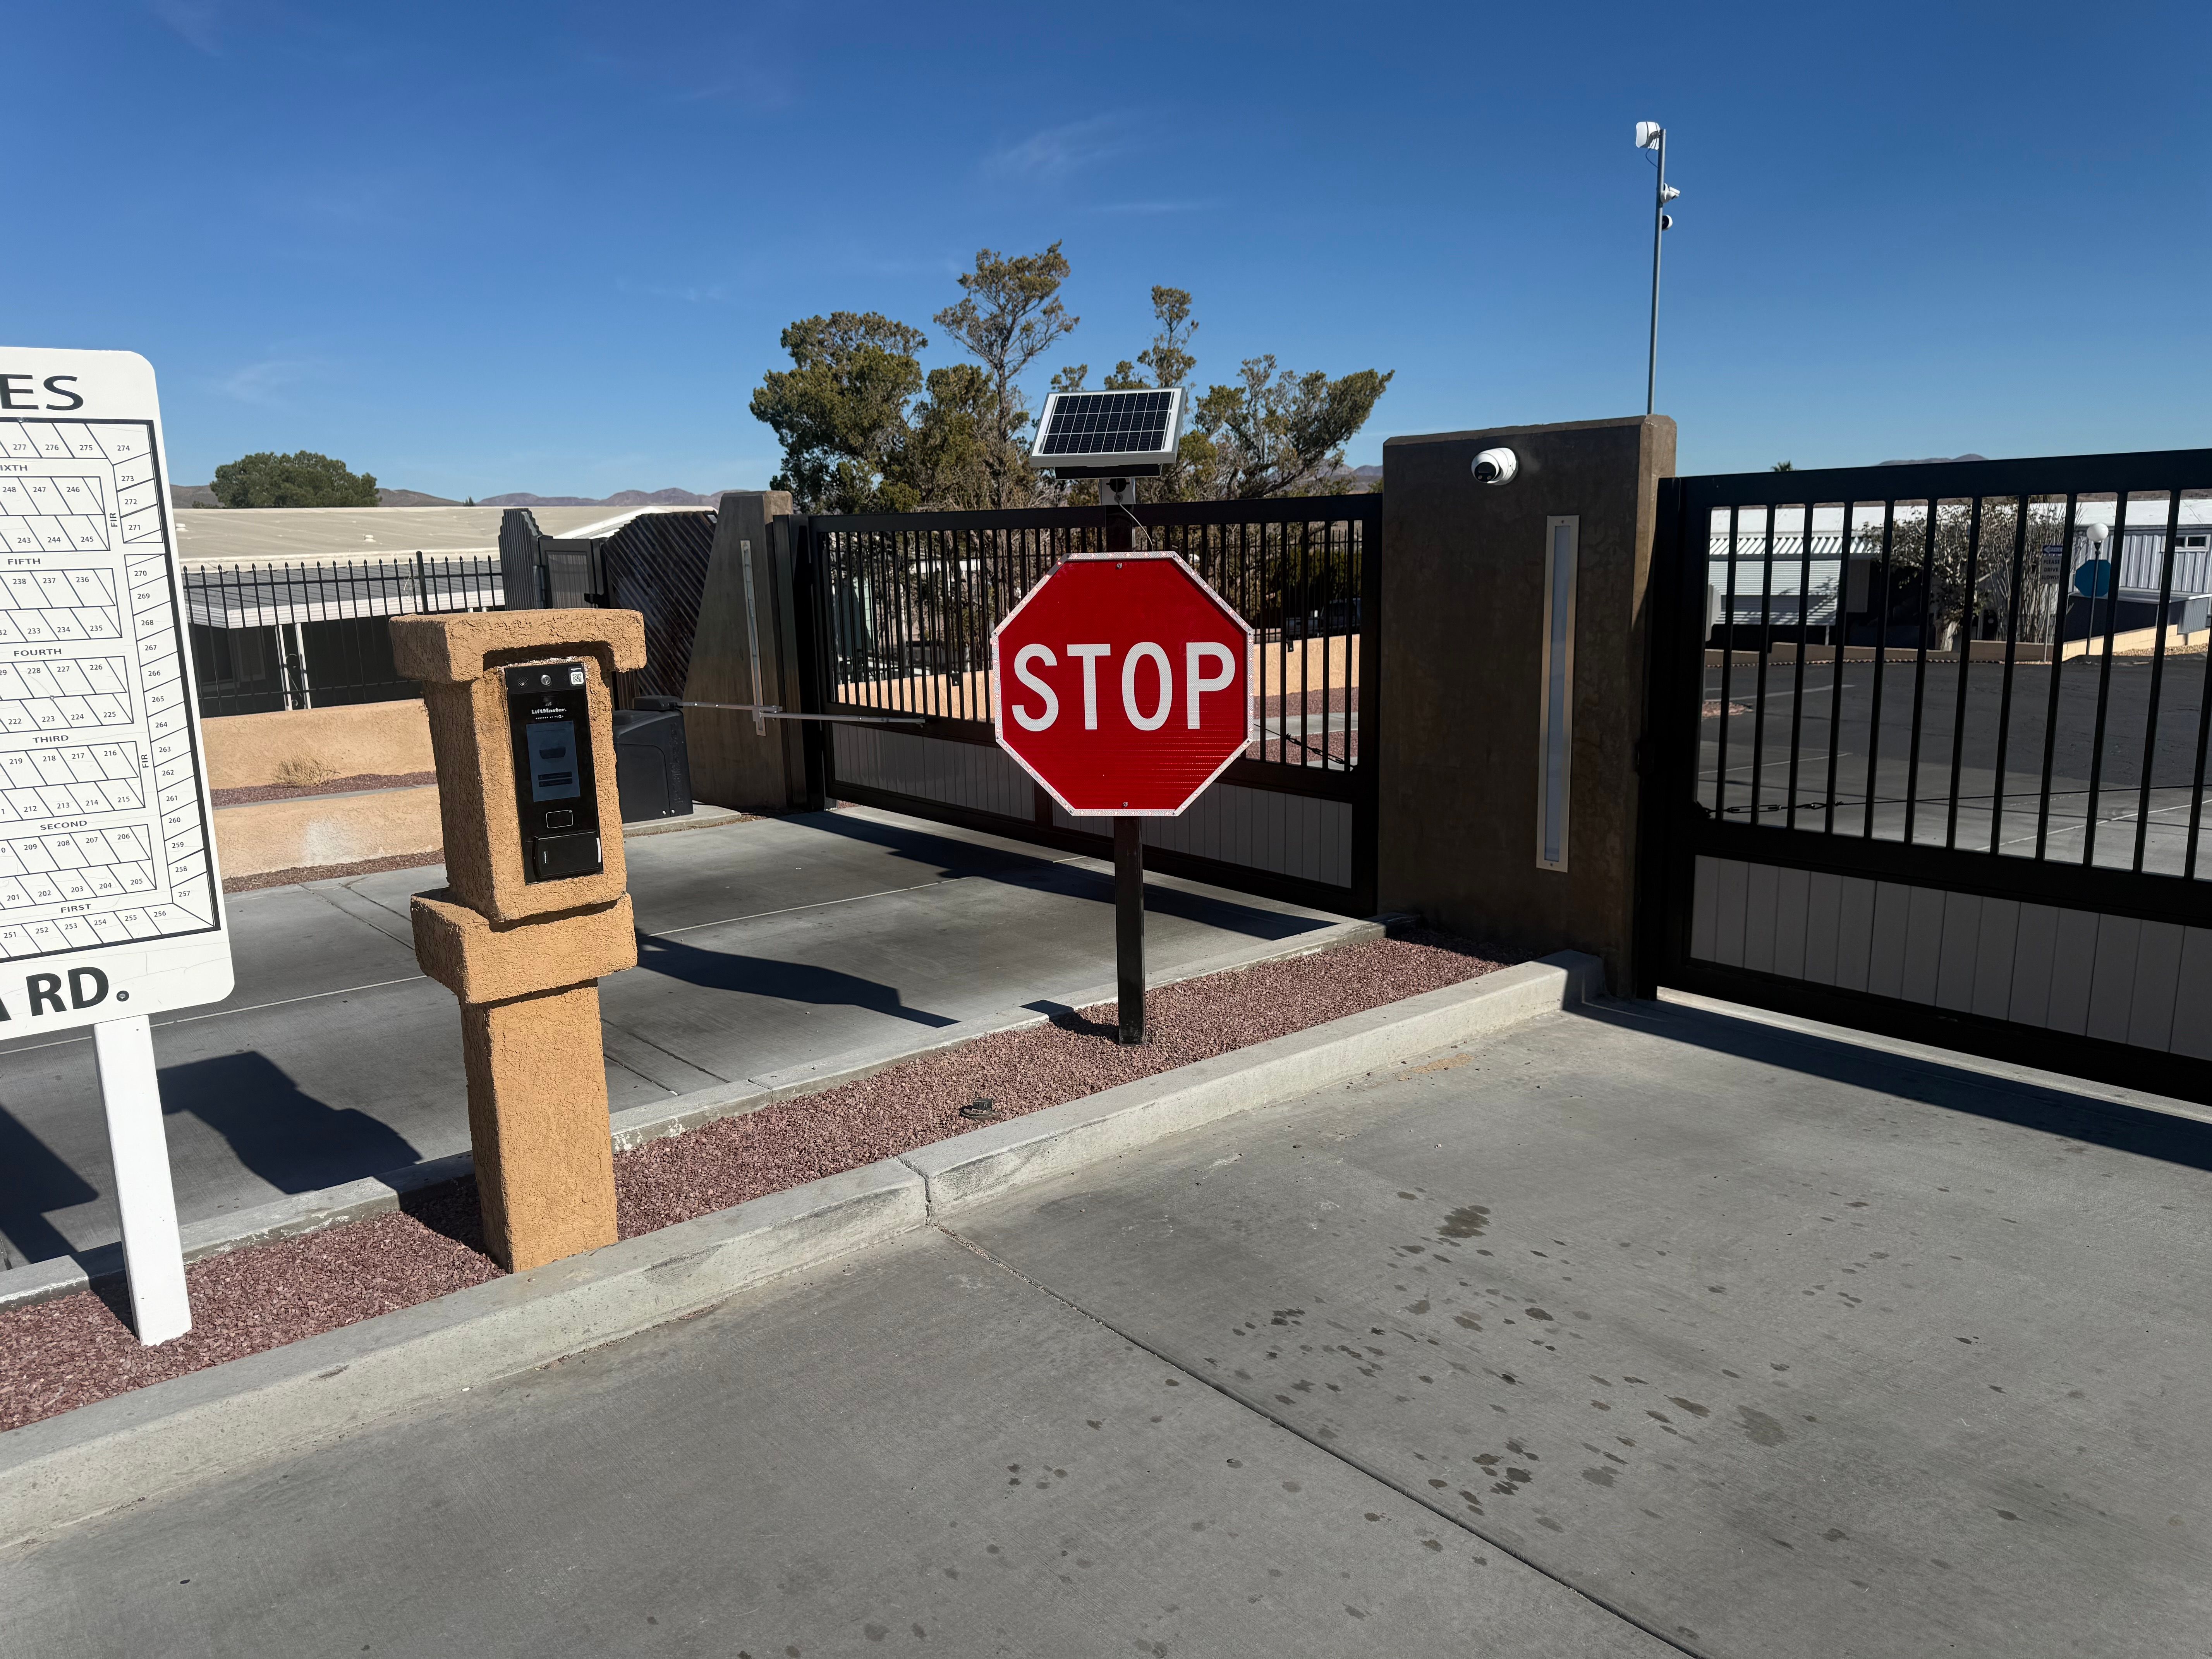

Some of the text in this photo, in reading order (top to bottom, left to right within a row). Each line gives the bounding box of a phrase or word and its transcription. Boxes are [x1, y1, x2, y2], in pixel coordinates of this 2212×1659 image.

[109, 513, 118, 527] FIR
[14, 648, 62, 657] FOURTH
[1012, 641, 1235, 732] STOP
[32, 735, 69, 743] THIRD
[141, 754, 149, 768] FIR
[40, 821, 87, 830] SECOND
[60, 903, 91, 913] FIRST
